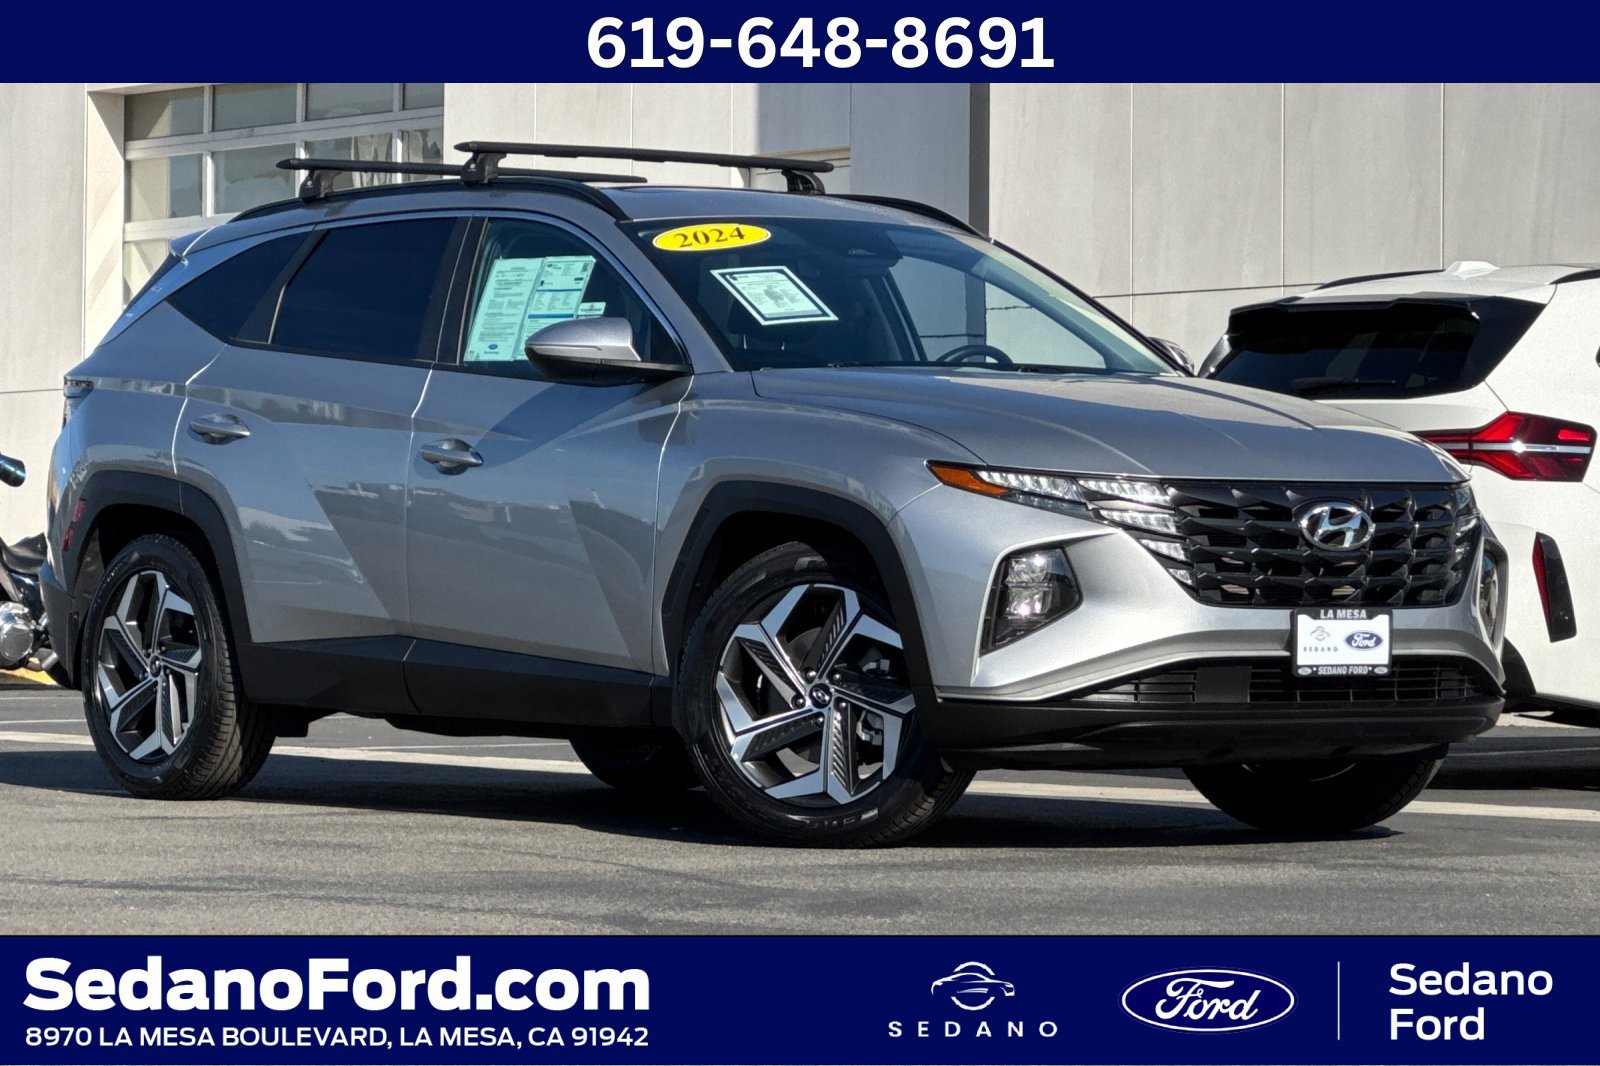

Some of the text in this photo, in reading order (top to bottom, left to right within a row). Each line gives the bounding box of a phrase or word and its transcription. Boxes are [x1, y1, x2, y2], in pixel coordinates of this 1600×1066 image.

[673, 226, 745, 248] 2024
[1320, 609, 1367, 619] LA MESA
[1351, 632, 1377, 647] Ford
[1317, 666, 1347, 675] SEDANO
[1348, 666, 1369, 675] FORD
